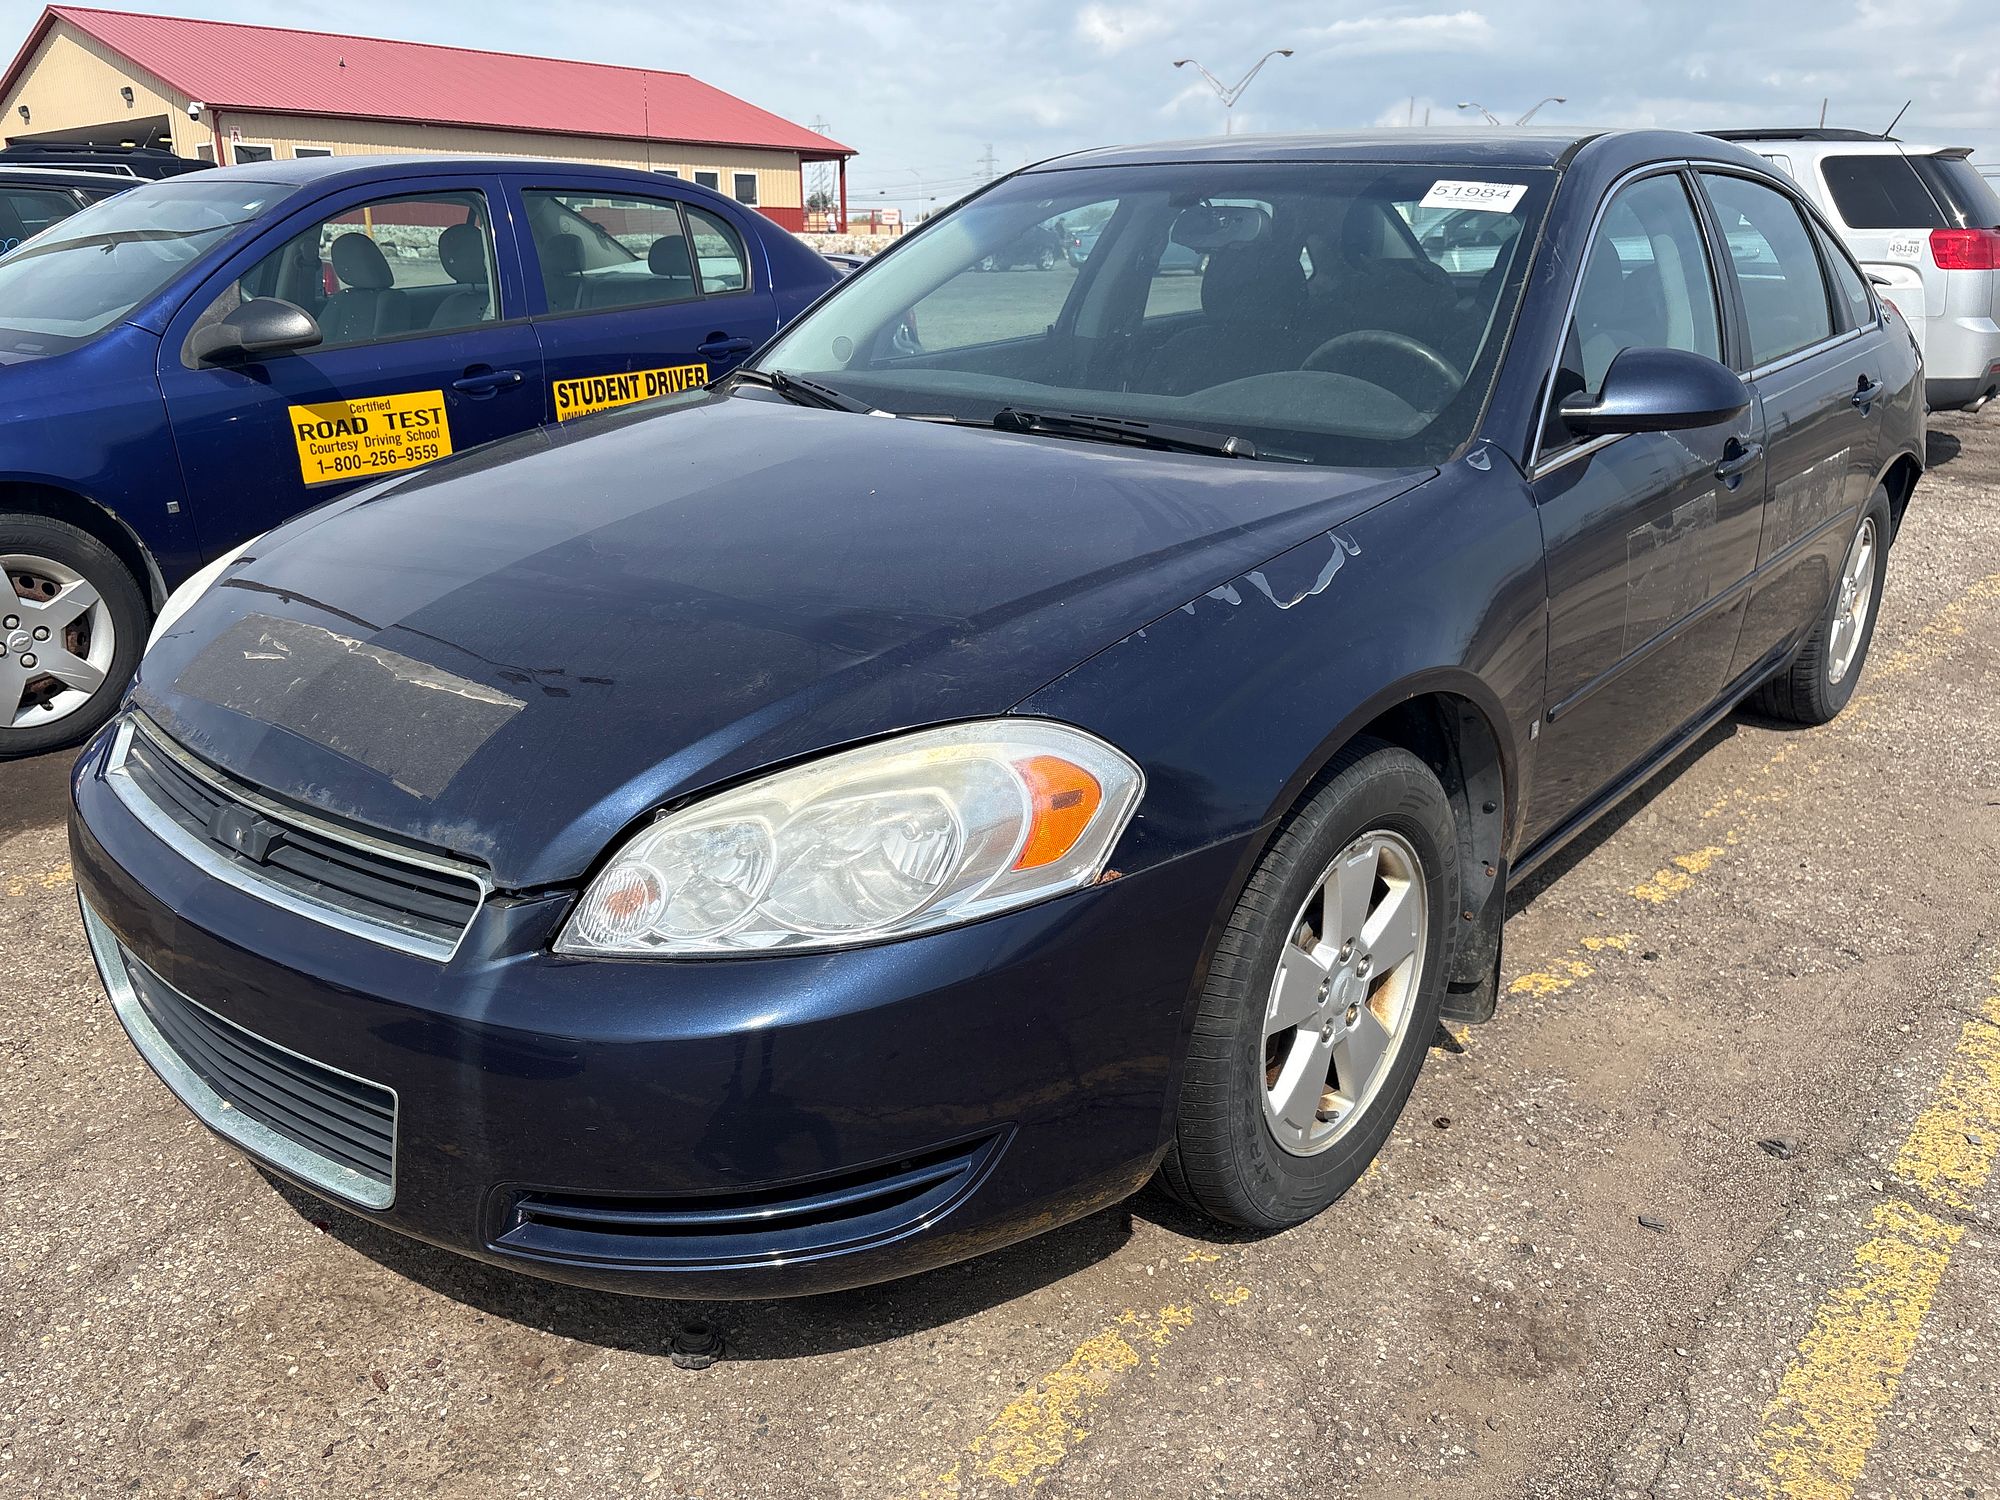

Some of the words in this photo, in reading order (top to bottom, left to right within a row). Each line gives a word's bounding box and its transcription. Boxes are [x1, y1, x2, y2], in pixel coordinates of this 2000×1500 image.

[1433, 185, 1511, 199] 51984
[557, 375, 639, 408] STUDENT
[645, 366, 705, 397] DRIVER
[349, 400, 391, 414] Certified
[297, 417, 369, 441] ROAD
[383, 407, 442, 430] TEST
[309, 439, 358, 455] Courtesy
[364, 434, 402, 447] Driving
[406, 427, 440, 442] School
[317, 443, 439, 474] 1-800-256-9559
[1244, 1044, 1275, 1184] ATREZZO
